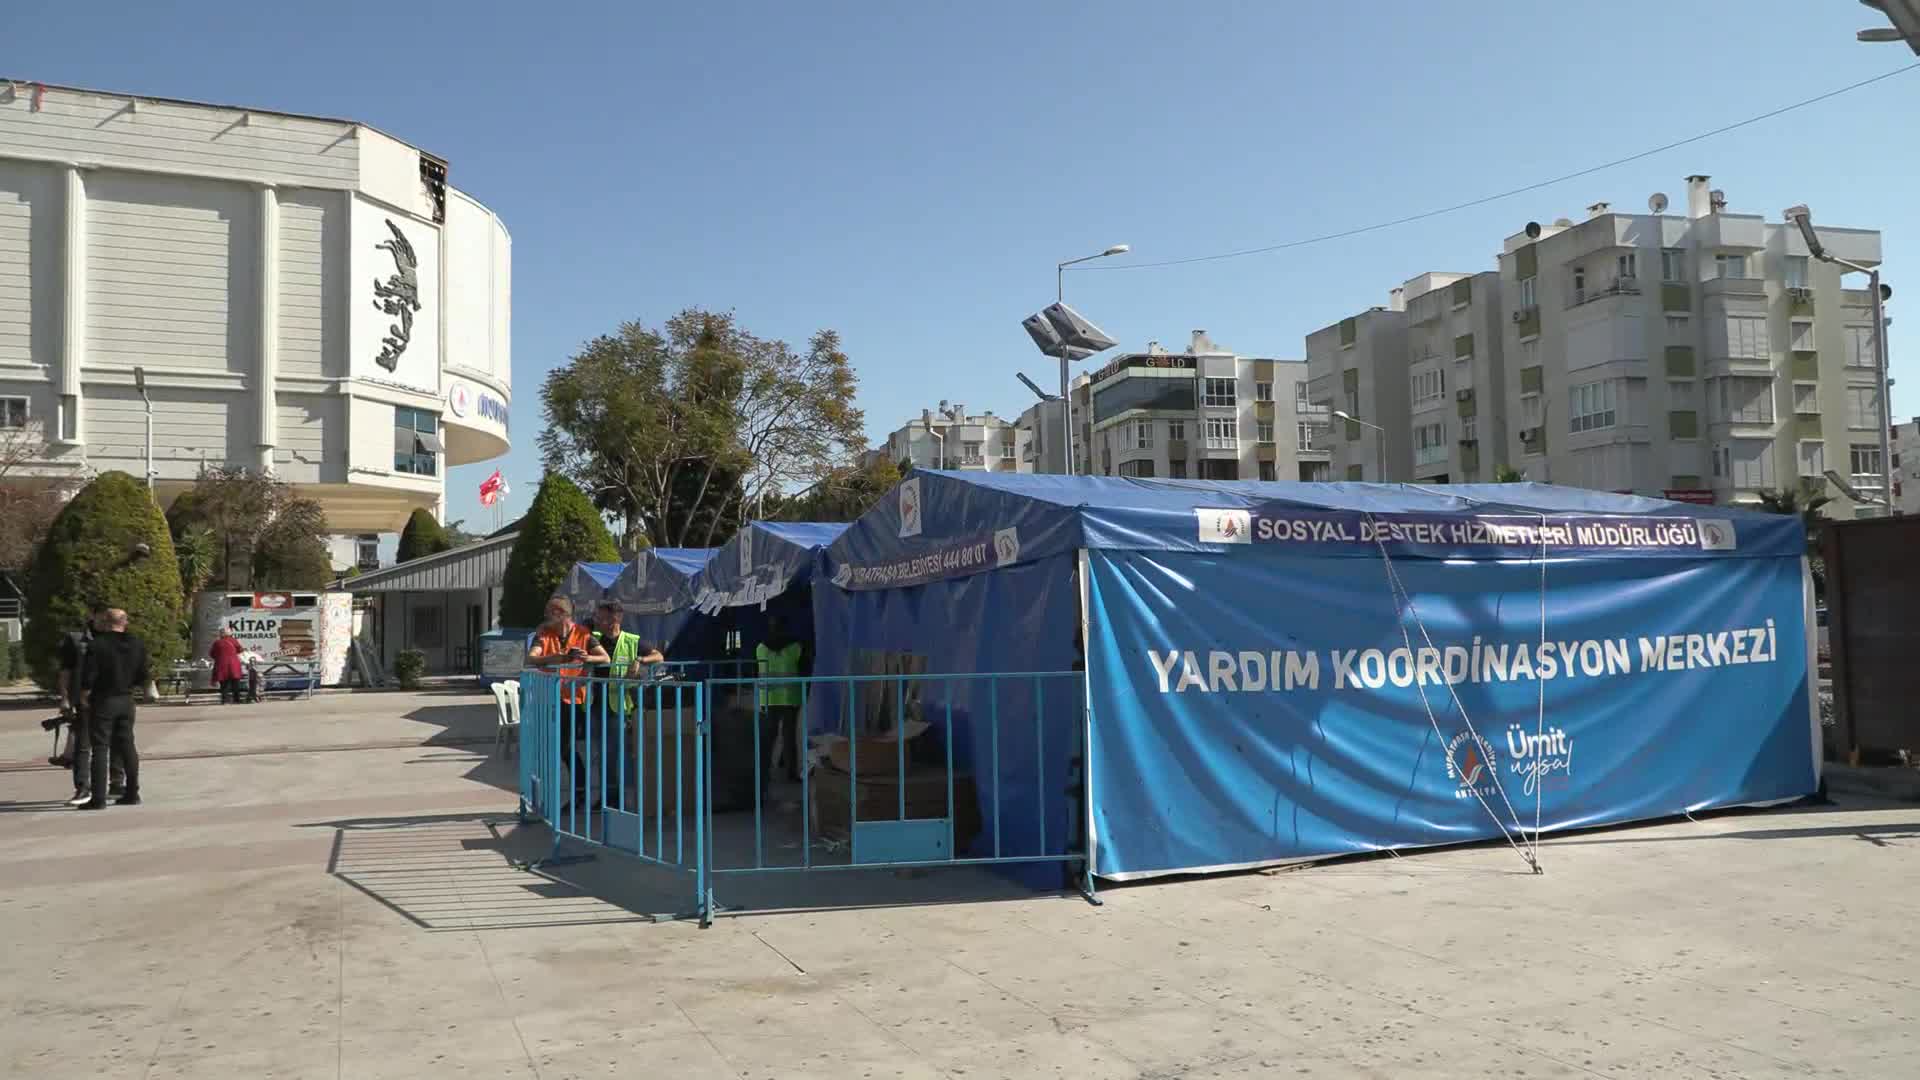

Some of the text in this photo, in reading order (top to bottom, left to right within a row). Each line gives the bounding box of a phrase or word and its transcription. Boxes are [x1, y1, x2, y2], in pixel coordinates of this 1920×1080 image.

[1258, 518, 1356, 542] SOSYAL
[1359, 520, 1448, 544] DESTEK
[1451, 519, 1574, 546] HİZMETLERİ
[1577, 522, 1697, 546] MÜDÜRLÜĞÜ
[943, 550, 961, 569] 444
[961, 546, 973, 566] 80
[974, 543, 987, 562] 07
[229, 617, 276, 632] KİTAP
[1147, 617, 1777, 693] YARDIM KOORDİNASYON MERKEZİ
[1506, 723, 1568, 759] Ümit
